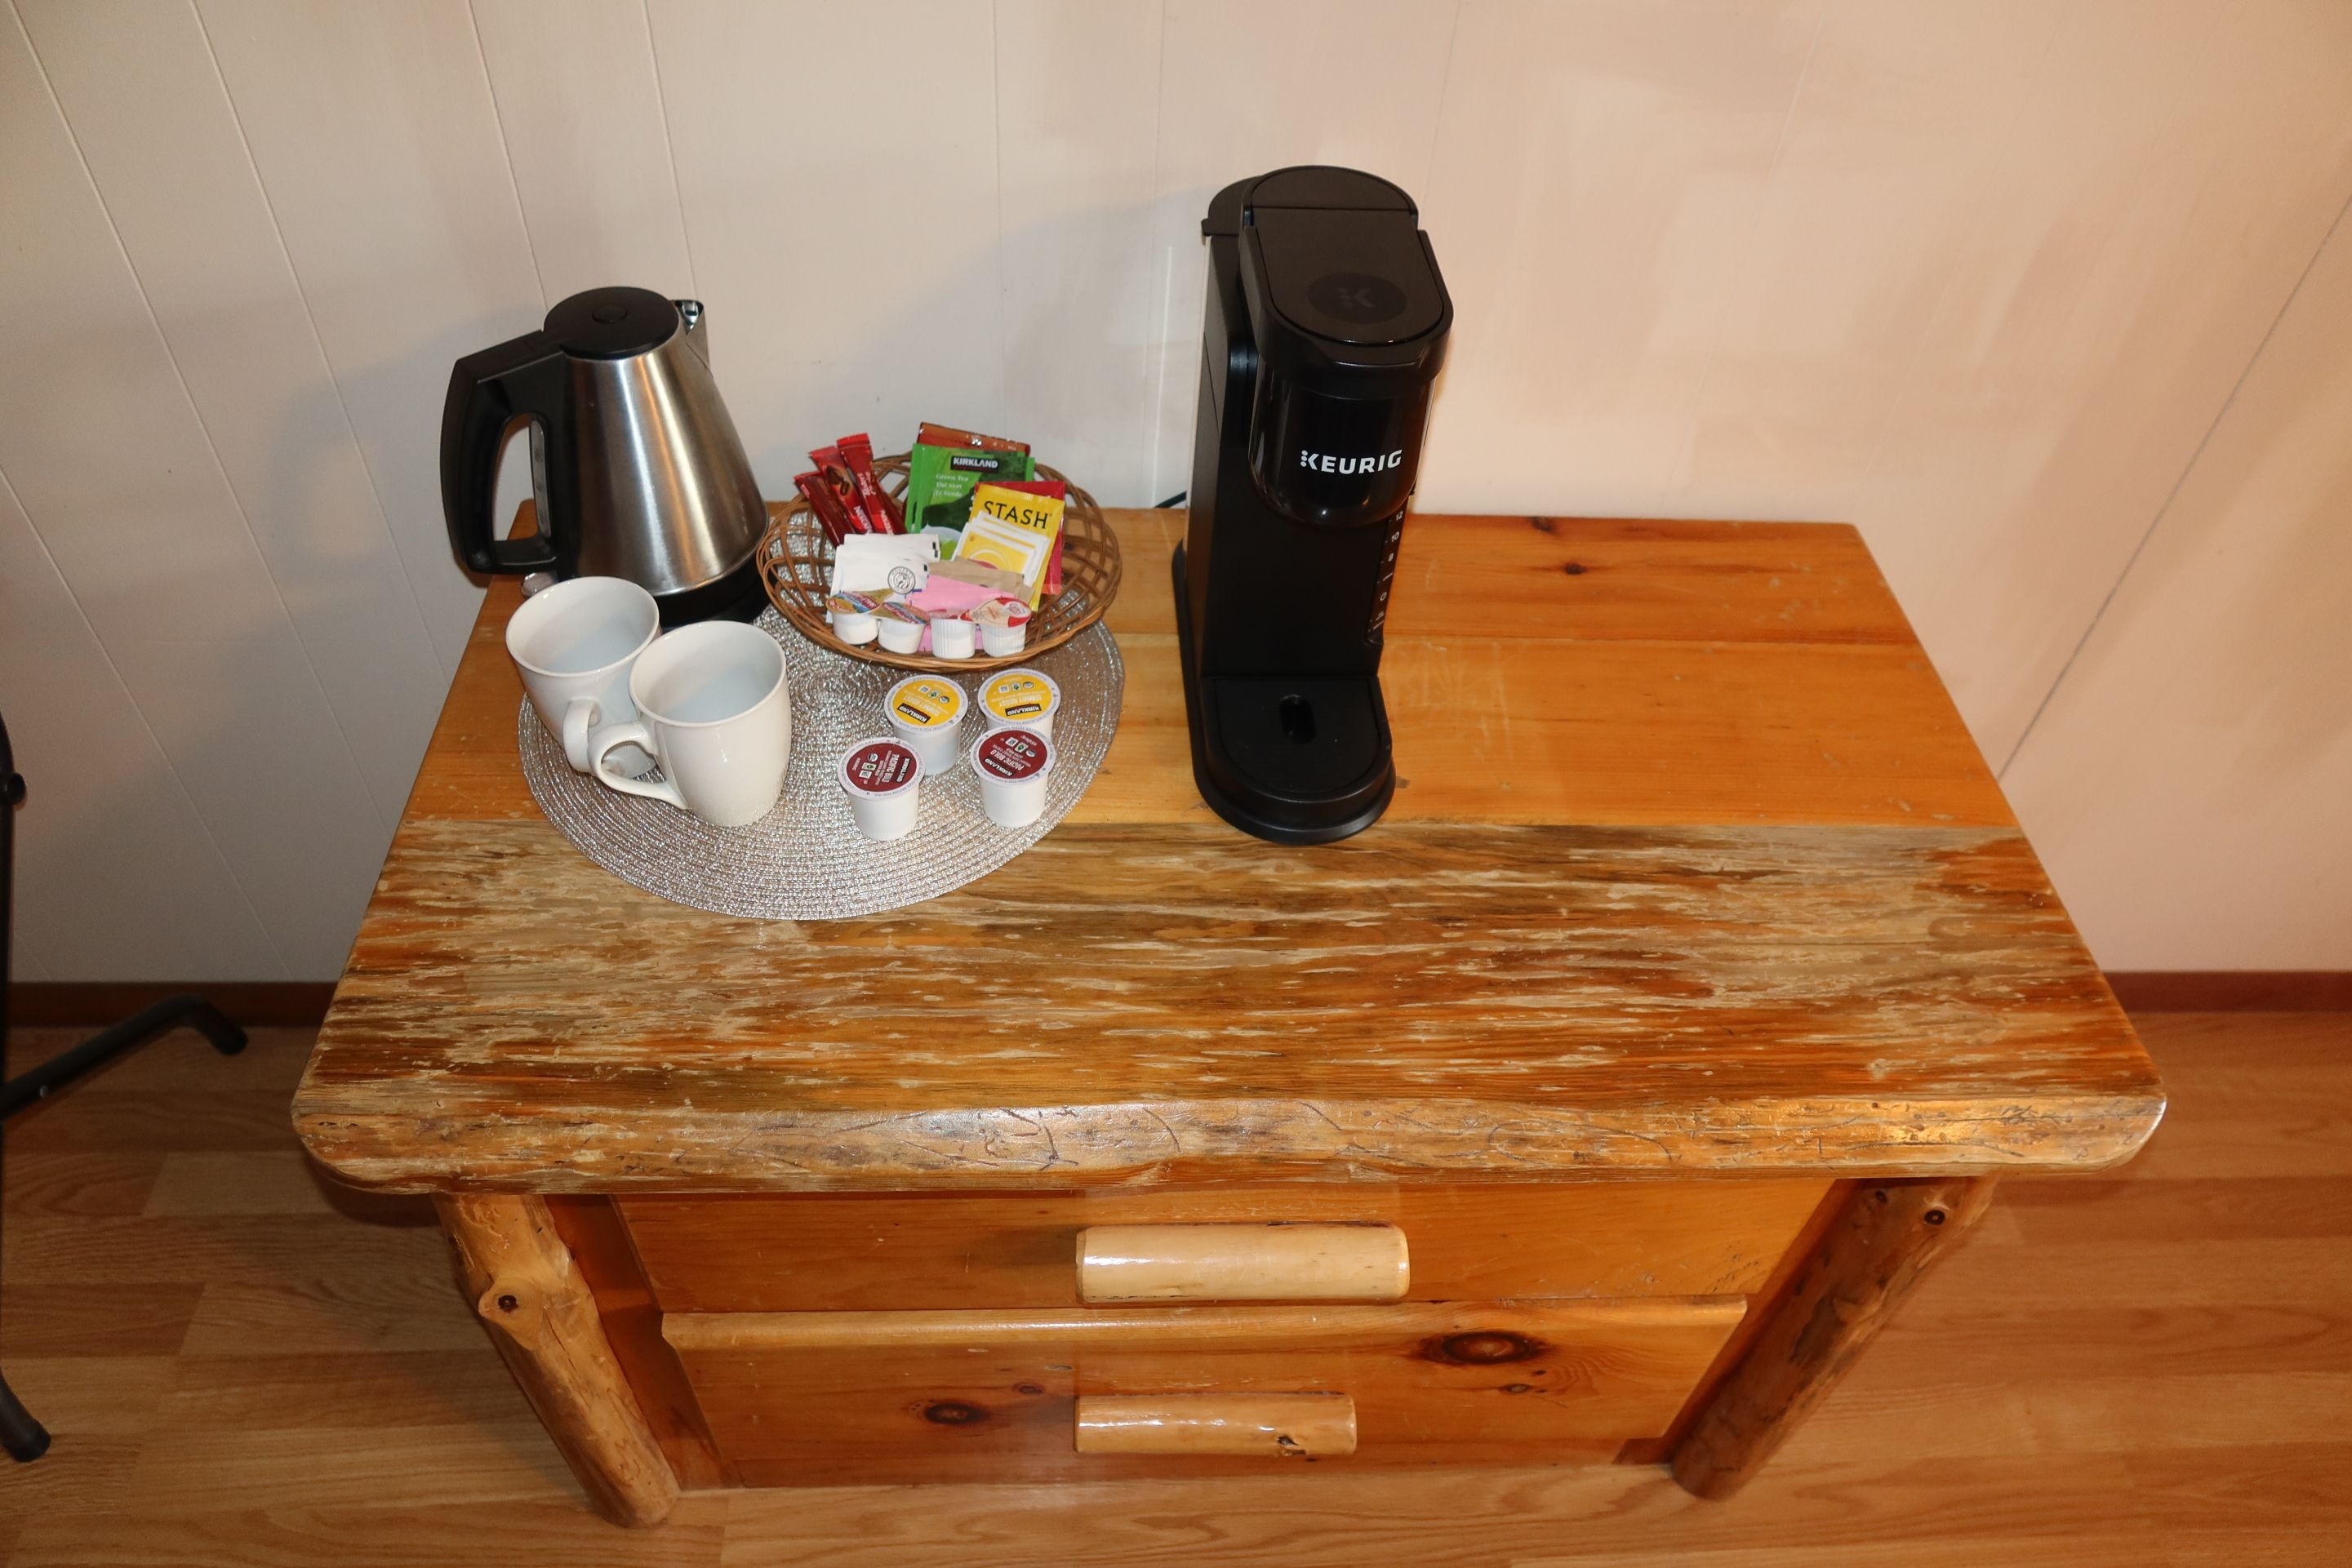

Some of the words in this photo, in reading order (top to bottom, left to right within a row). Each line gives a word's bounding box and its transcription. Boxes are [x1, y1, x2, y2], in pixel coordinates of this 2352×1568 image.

[953, 457, 998, 469] KIRKLAND
[1300, 449, 1403, 475] KEURIG
[984, 500, 1049, 530] STASH
[1395, 511, 1403, 521] 12
[1391, 531, 1400, 542] 10
[1388, 553, 1394, 562] 8
[899, 705, 927, 722] KIRKLAND
[1007, 706, 1040, 716] KIRKLAND
[990, 749, 1007, 761] BOLD
[985, 758, 1013, 777] KIRKLAND
[1003, 757, 1025, 771] PACIFIC
